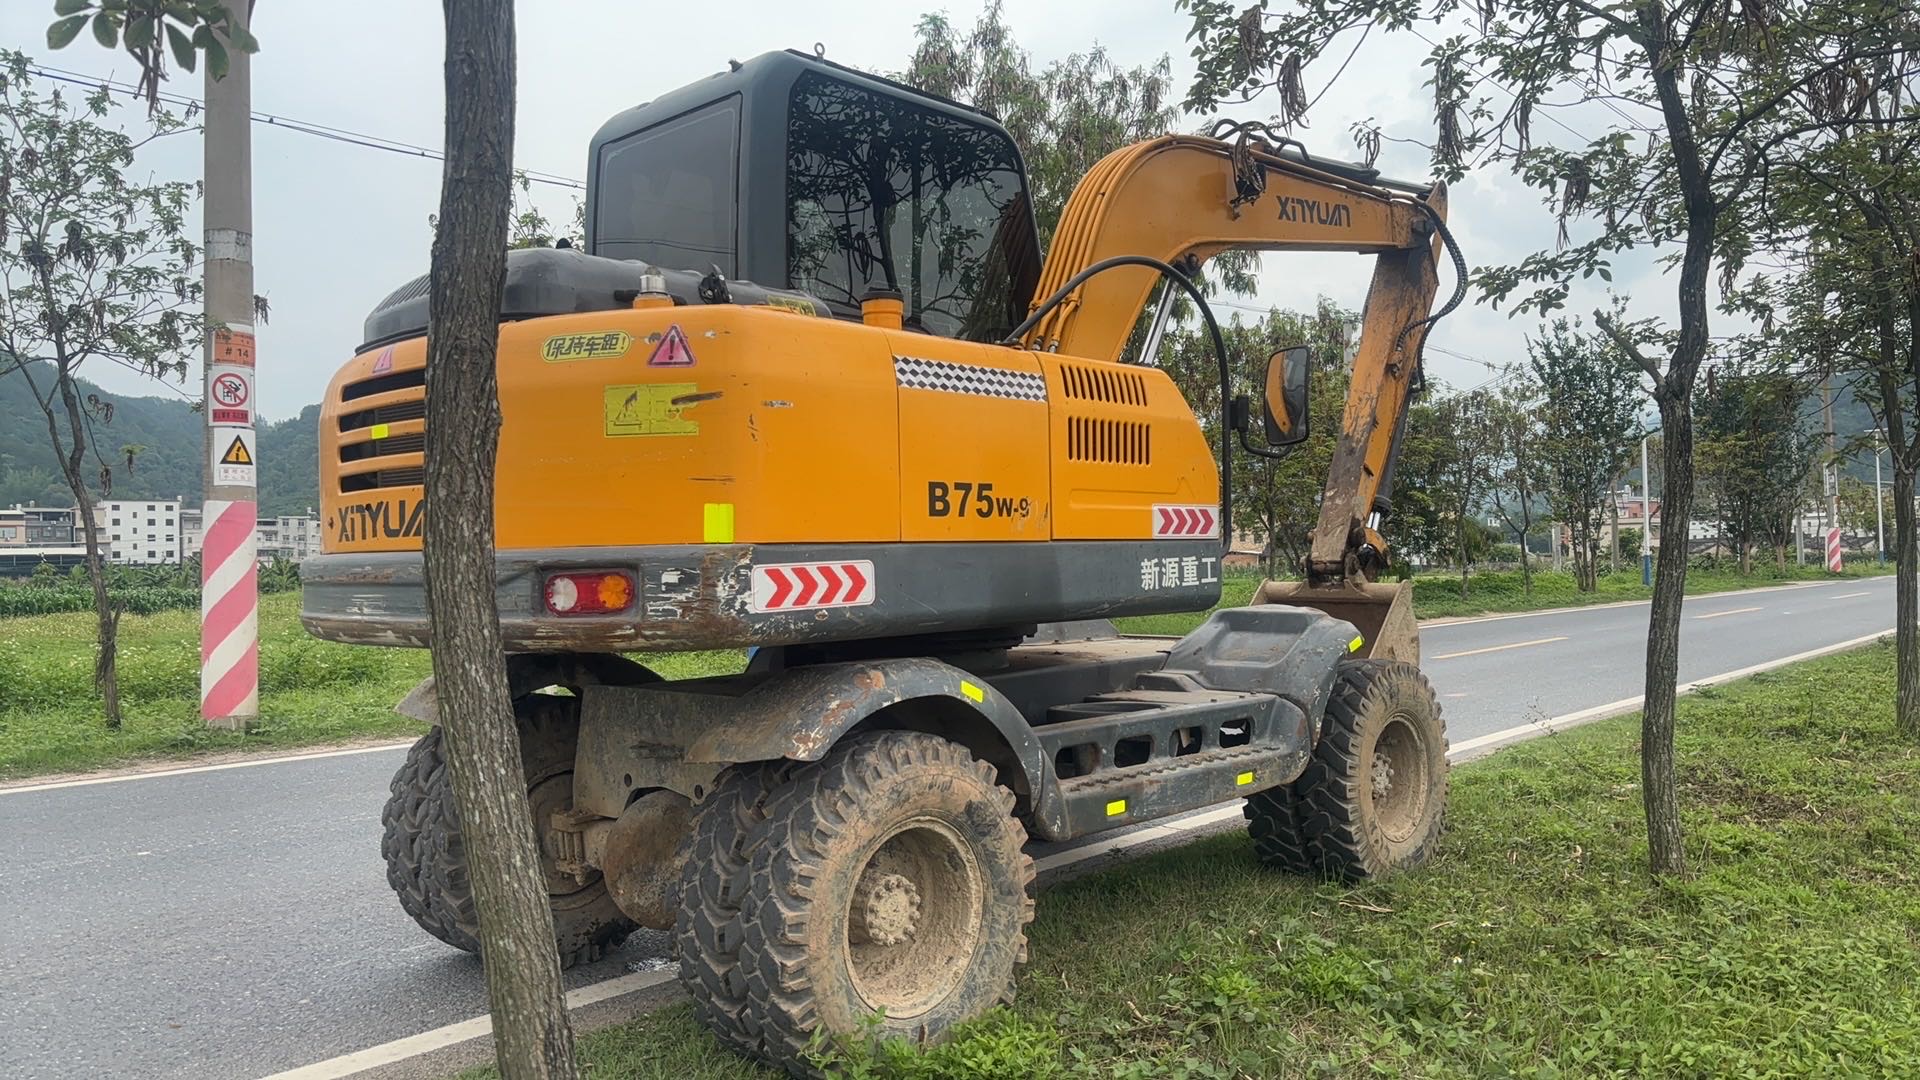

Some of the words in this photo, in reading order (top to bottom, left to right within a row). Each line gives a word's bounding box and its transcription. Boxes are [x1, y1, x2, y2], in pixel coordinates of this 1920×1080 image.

[338, 500, 425, 543] XINYUA
[1141, 556, 1218, 590] 新源重工
